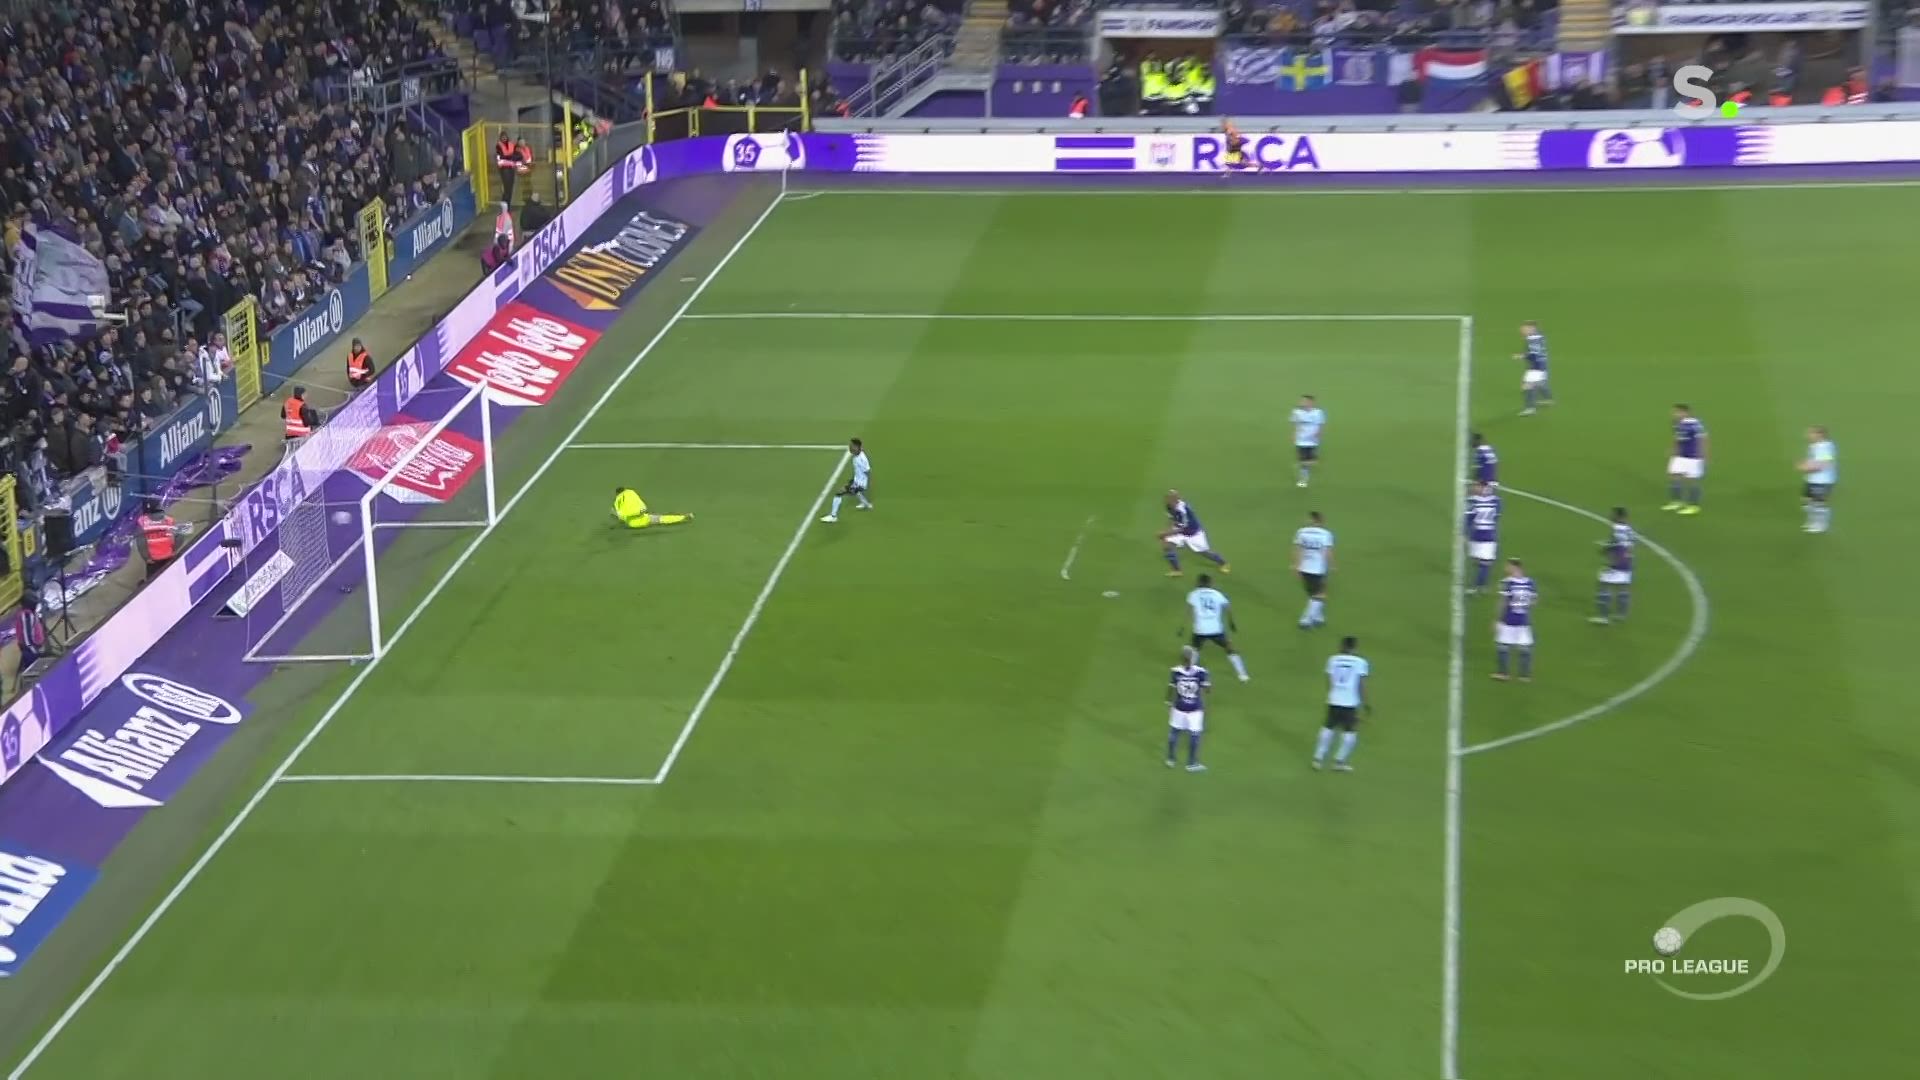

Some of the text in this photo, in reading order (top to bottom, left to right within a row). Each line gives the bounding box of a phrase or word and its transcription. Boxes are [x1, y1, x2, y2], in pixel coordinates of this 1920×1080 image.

[413, 215, 441, 258] Allianz
[532, 216, 567, 276] RSCA
[293, 309, 330, 360] Allianz
[160, 411, 205, 469] Allianz
[247, 456, 307, 545] RSCA
[60, 706, 202, 790] Allianz
